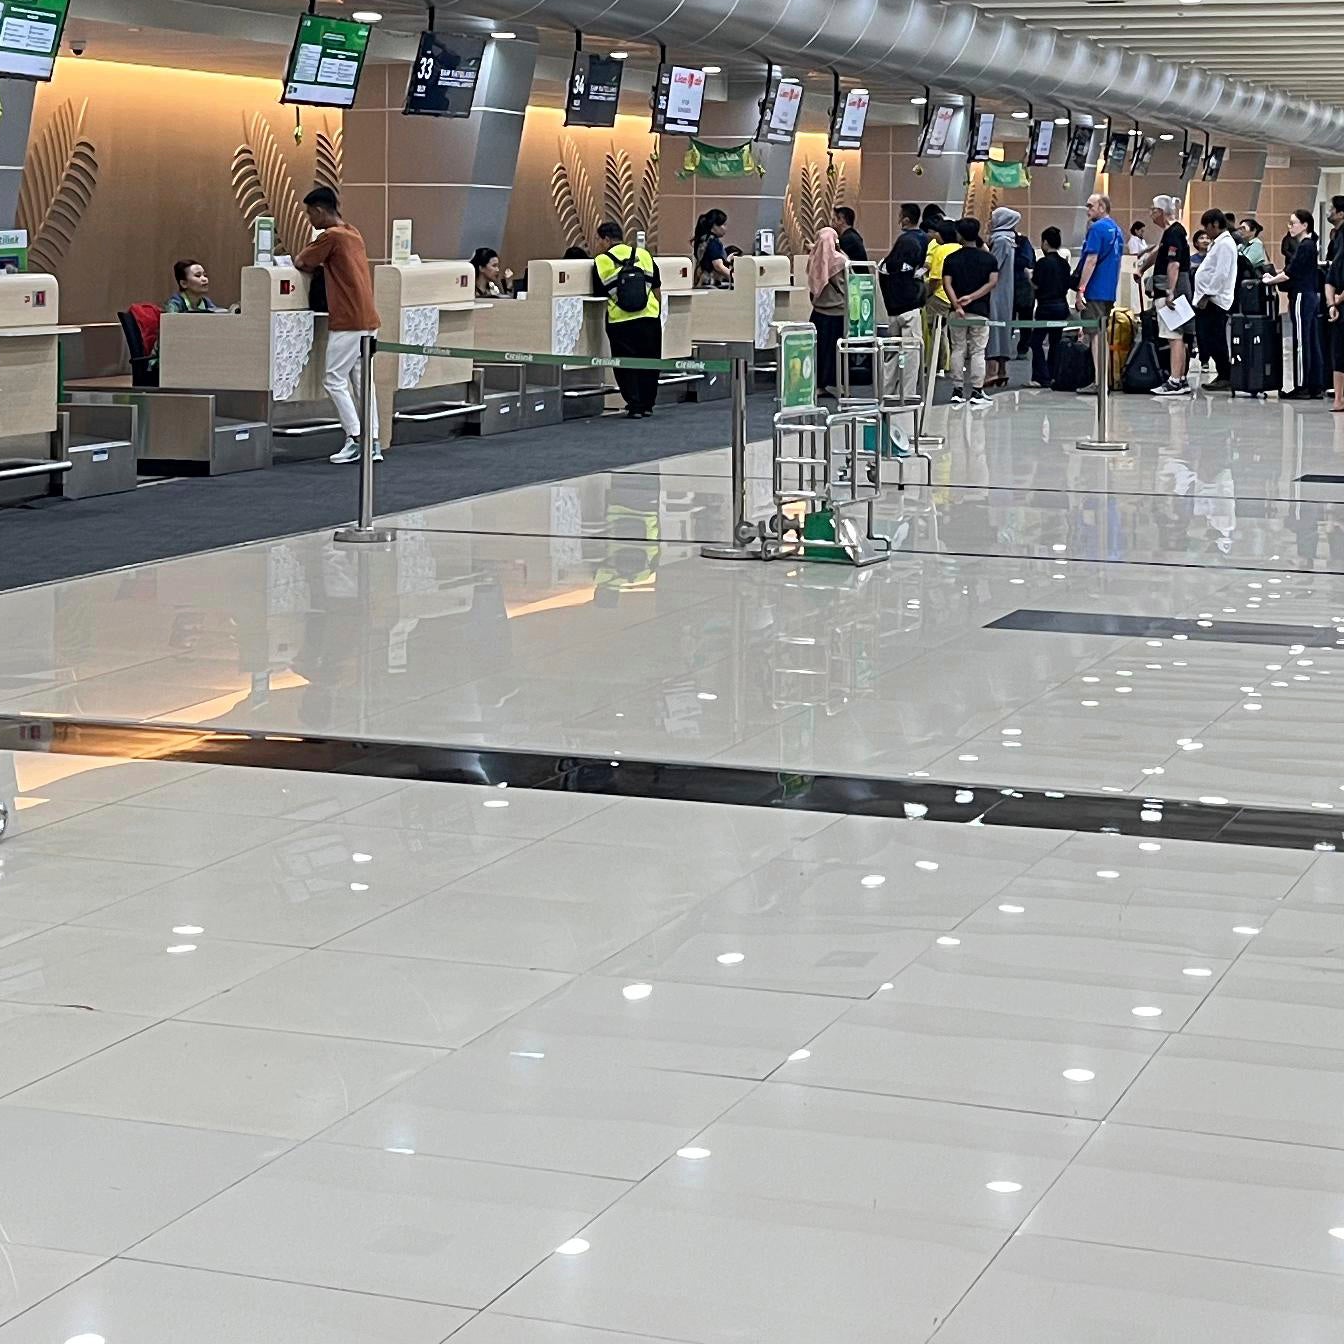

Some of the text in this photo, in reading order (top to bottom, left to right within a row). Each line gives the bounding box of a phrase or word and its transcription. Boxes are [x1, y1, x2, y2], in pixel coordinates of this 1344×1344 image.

[417, 57, 434, 80] 33
[573, 74, 585, 94] 34
[675, 360, 706, 370] Citilink
